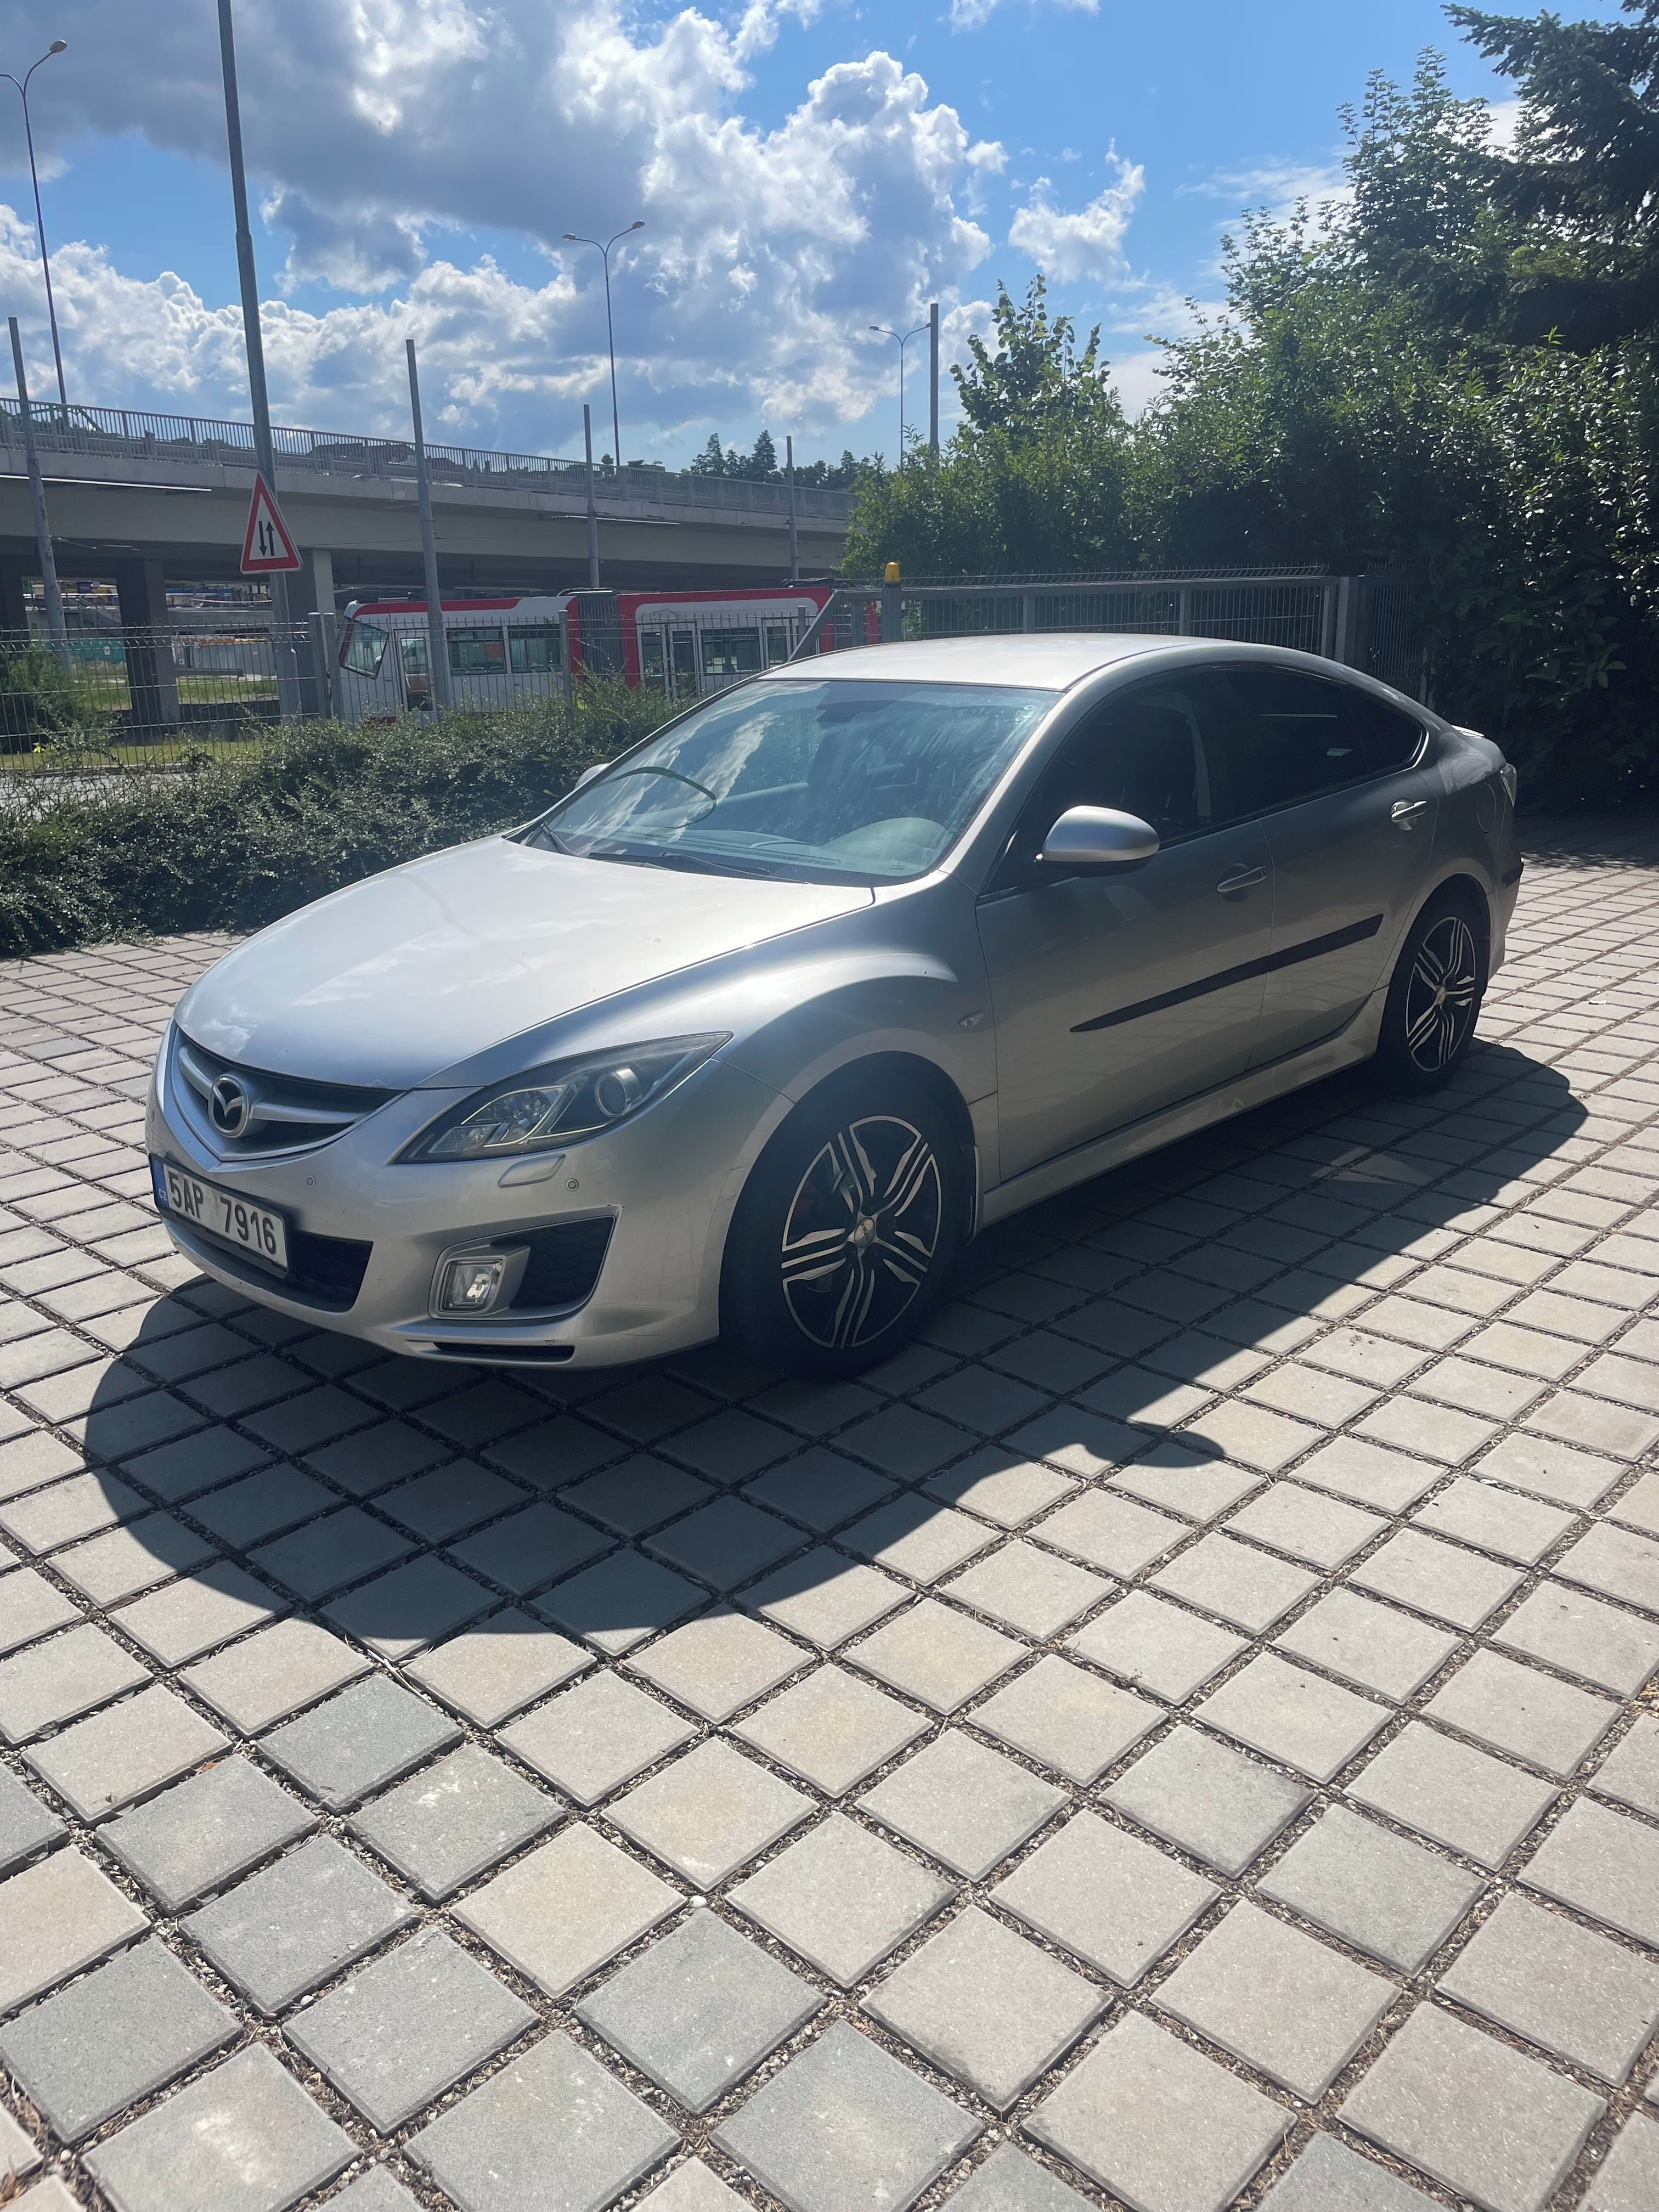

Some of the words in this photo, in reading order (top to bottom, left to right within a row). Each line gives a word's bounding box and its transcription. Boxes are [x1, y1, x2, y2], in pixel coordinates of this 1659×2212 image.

[158, 1188, 167, 1201] CZ
[168, 1171, 204, 1219] 5AP
[219, 1196, 276, 1255] 7916
